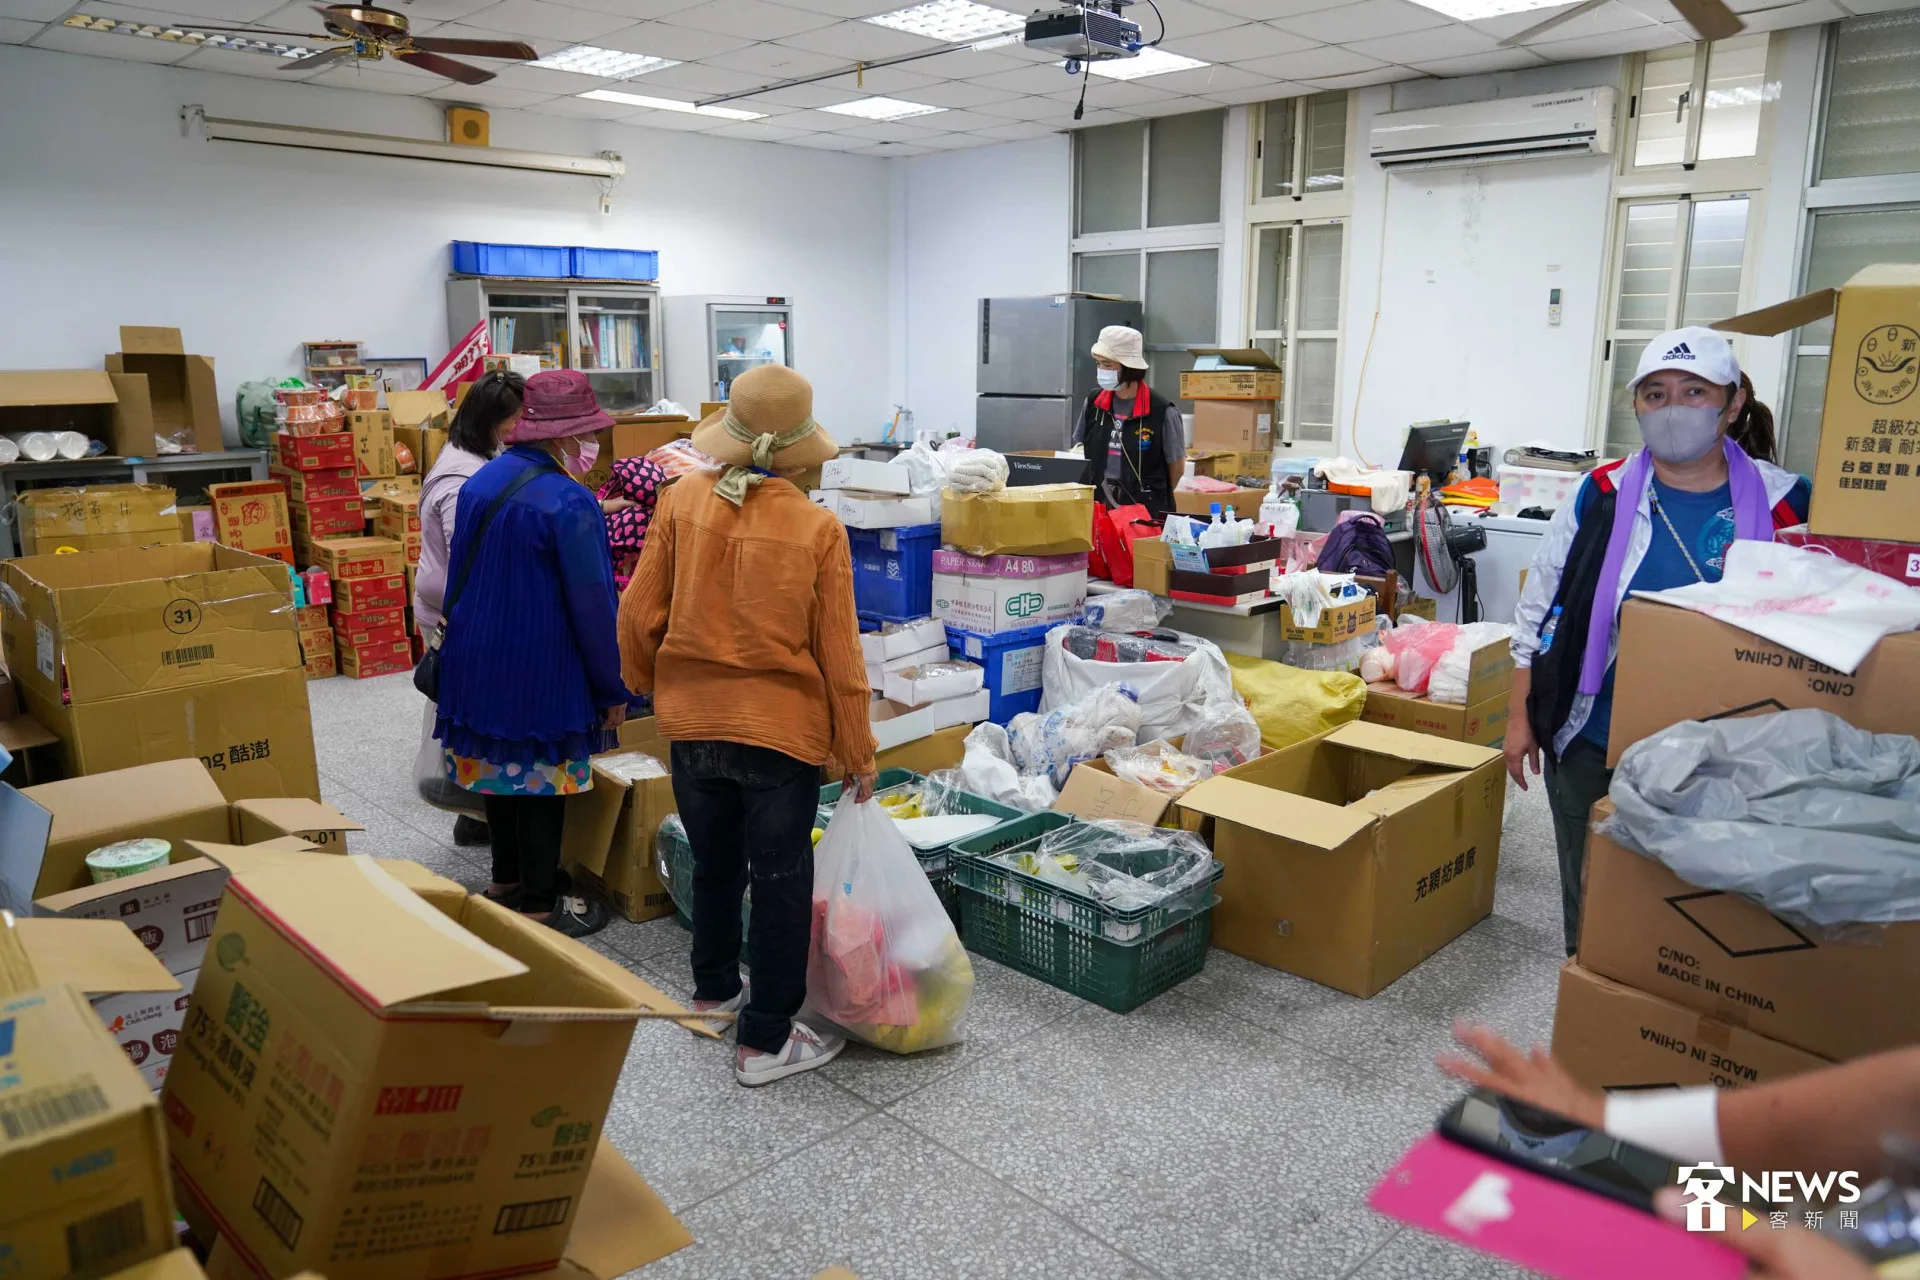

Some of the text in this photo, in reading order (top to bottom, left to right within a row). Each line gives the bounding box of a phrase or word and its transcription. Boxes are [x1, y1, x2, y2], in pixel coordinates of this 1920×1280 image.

[1662, 353, 1696, 361] adidas
[1013, 461, 1043, 471] ViewSonic
[339, 560, 383, 577] 味味一品
[940, 555, 987, 568] PAPER STAR
[1005, 559, 1019, 573] A4
[1021, 559, 1035, 574] 80
[173, 608, 193, 625] 31
[1734, 647, 1783, 667] CHINA
[1787, 655, 1803, 671] IN
[1807, 678, 1855, 697] C/NO:
[229, 739, 270, 765] 酷澎
[1658, 945, 1700, 970] C/NO:
[1656, 961, 1777, 1014] MADE IN CHINA
[1640, 1026, 1758, 1082] MADE IN CHINA
